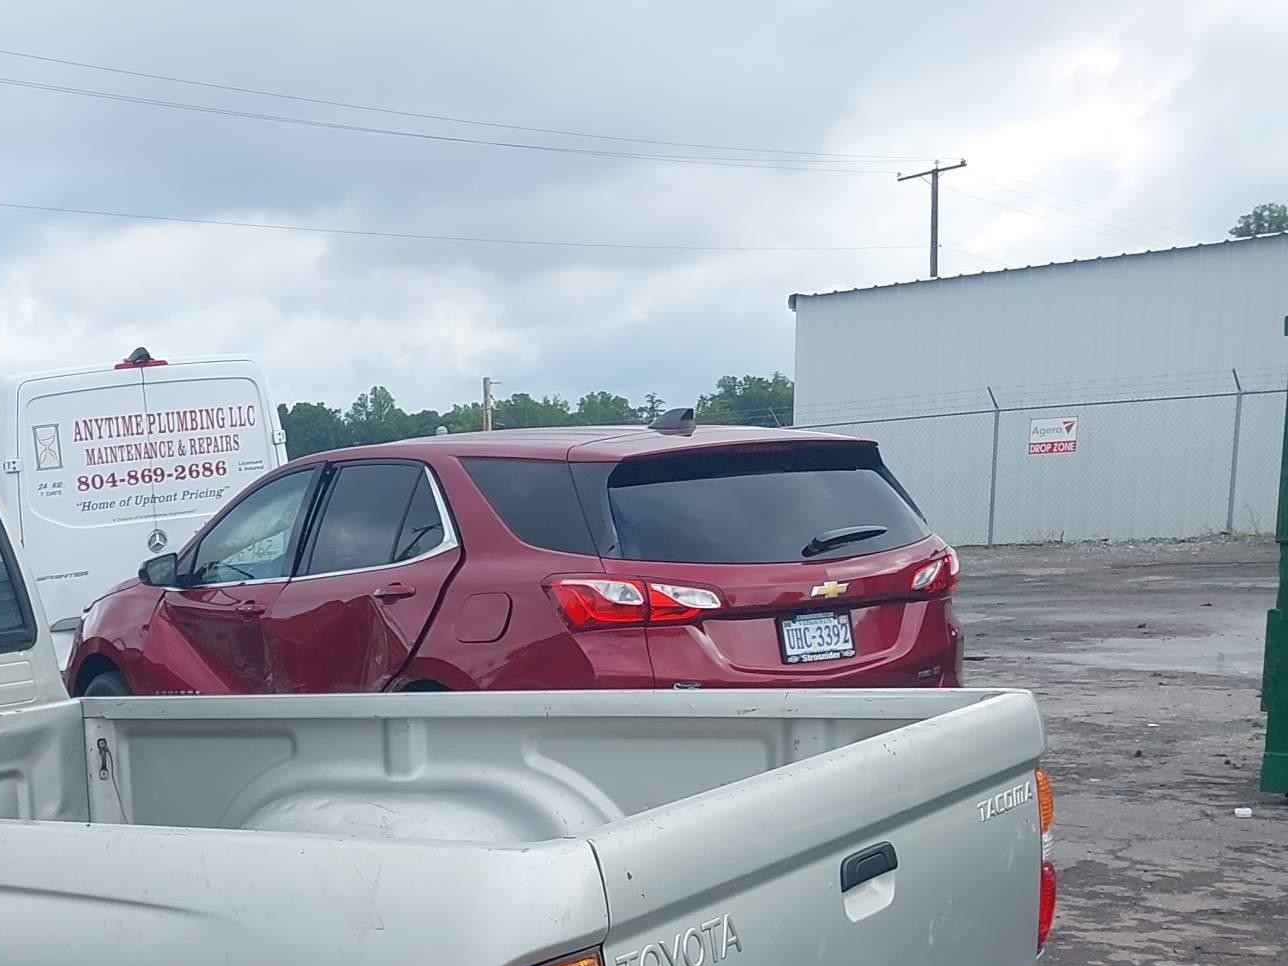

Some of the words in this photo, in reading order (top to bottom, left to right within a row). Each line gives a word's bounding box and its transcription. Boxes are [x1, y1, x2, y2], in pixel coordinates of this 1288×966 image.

[74, 414, 145, 443] ANYTIME
[148, 407, 226, 436] PLUMBING
[228, 404, 256, 428] LLC
[1032, 426, 1063, 438] Agero
[85, 439, 174, 467] MAINTENANCE
[177, 439, 187, 458] &
[189, 433, 240, 456] REPAIRS
[1030, 443, 1053, 454] DROP
[1053, 441, 1076, 453] ZONE
[38, 483, 48, 491] 24
[77, 460, 228, 492] 804-869-2686
[119, 496, 133, 509] of
[134, 490, 178, 507] Upfront
[976, 781, 1033, 822] TACOMA
